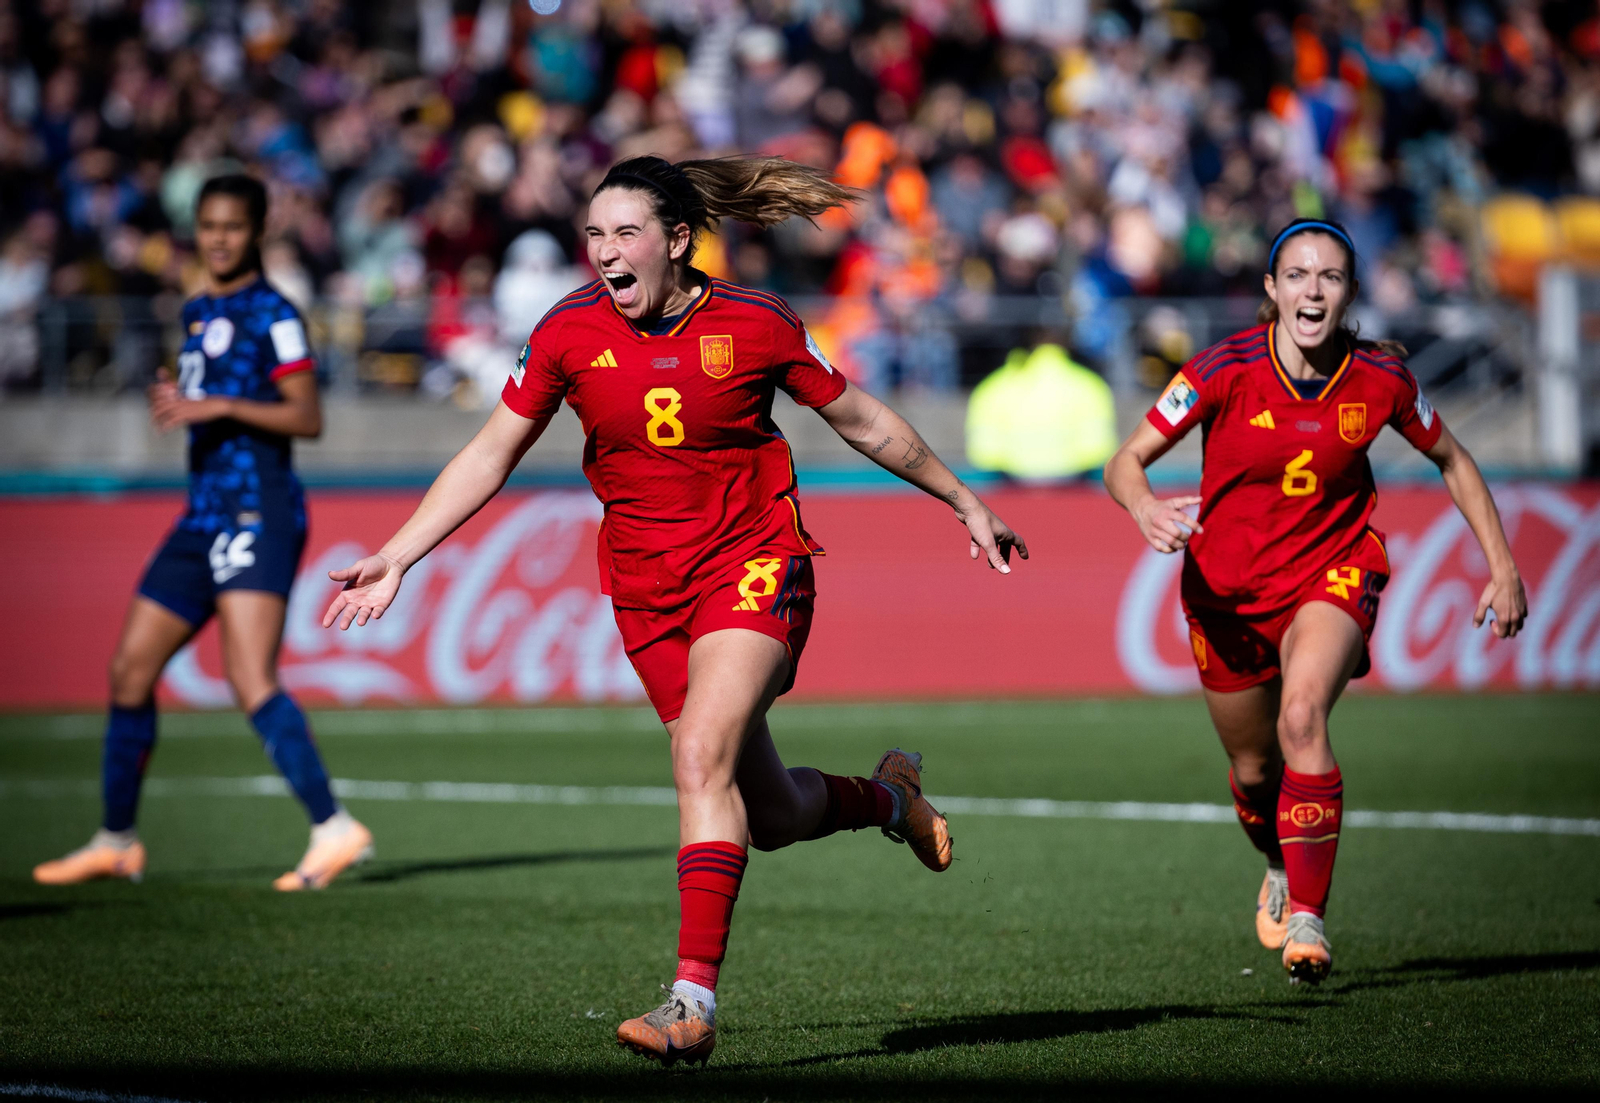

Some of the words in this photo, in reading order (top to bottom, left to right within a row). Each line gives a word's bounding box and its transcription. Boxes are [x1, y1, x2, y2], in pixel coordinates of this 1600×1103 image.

[644, 387, 685, 447] 8
[1281, 449, 1317, 497] 6
[737, 558, 782, 598] 8
